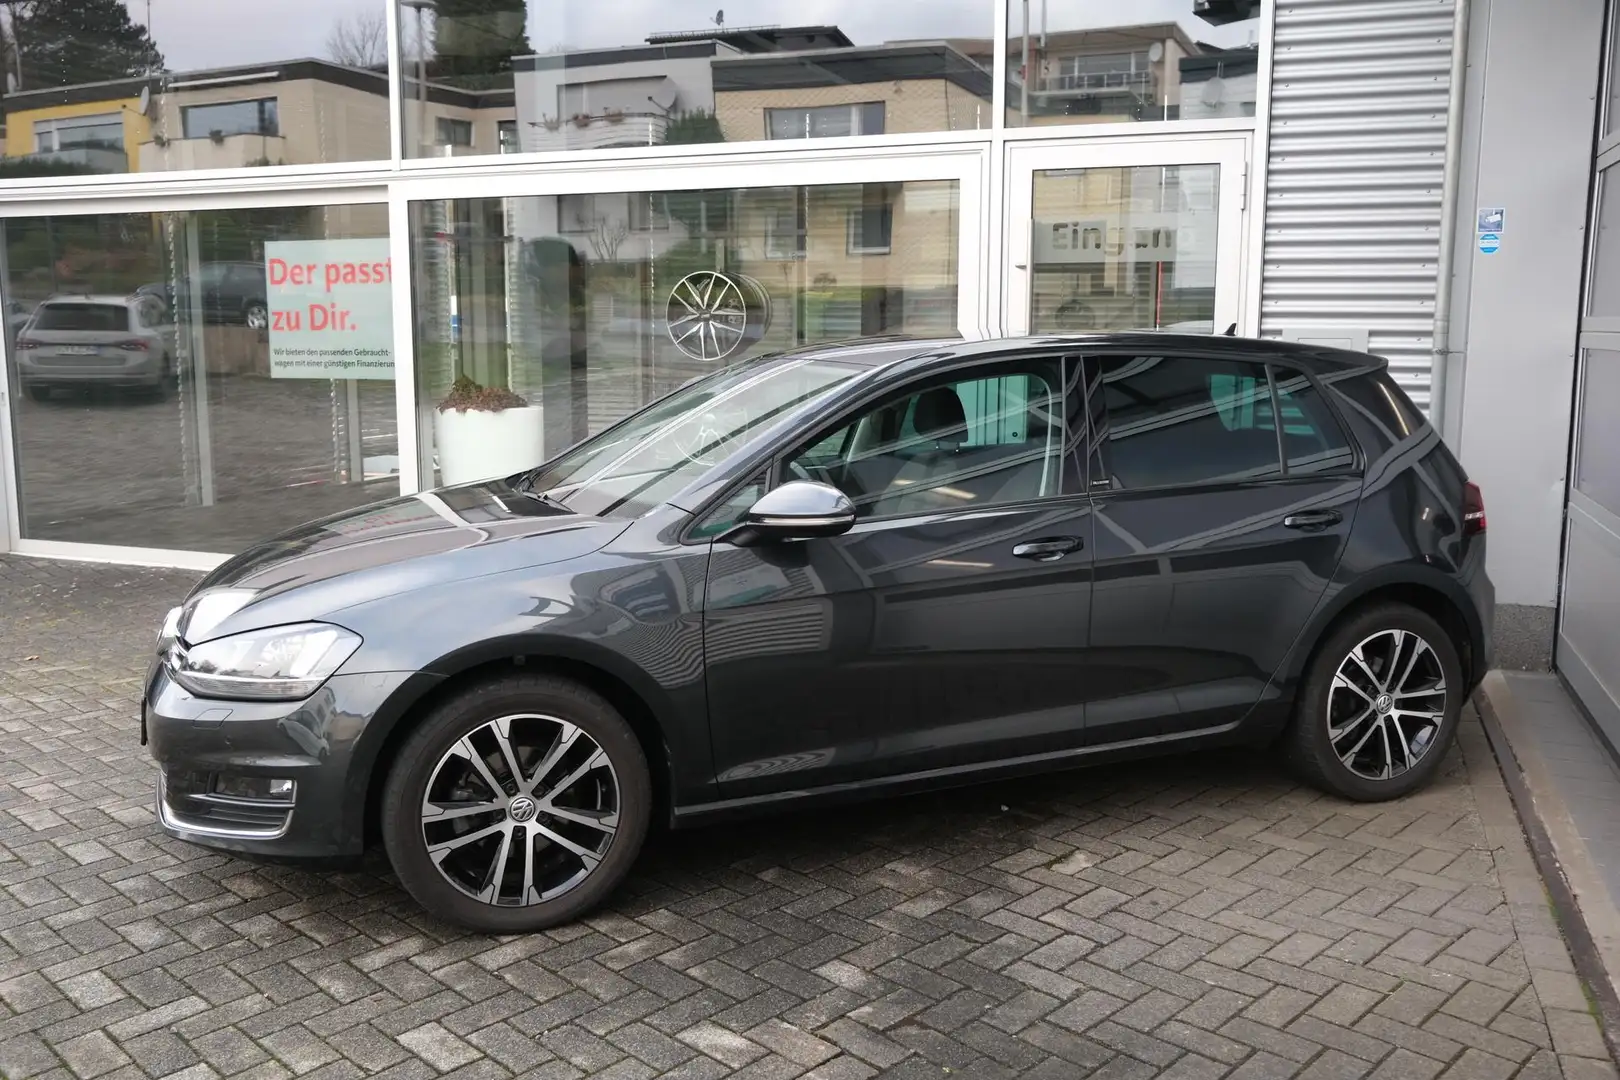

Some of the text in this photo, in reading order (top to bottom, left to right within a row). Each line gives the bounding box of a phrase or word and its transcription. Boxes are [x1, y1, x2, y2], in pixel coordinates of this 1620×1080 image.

[269, 257, 316, 285] Der
[271, 302, 357, 331] zu Dir.
[274, 348, 391, 357] Wir bieten den passenden Gebraucht-
[274, 361, 294, 369] wagen
[324, 360, 354, 369] günstigen
